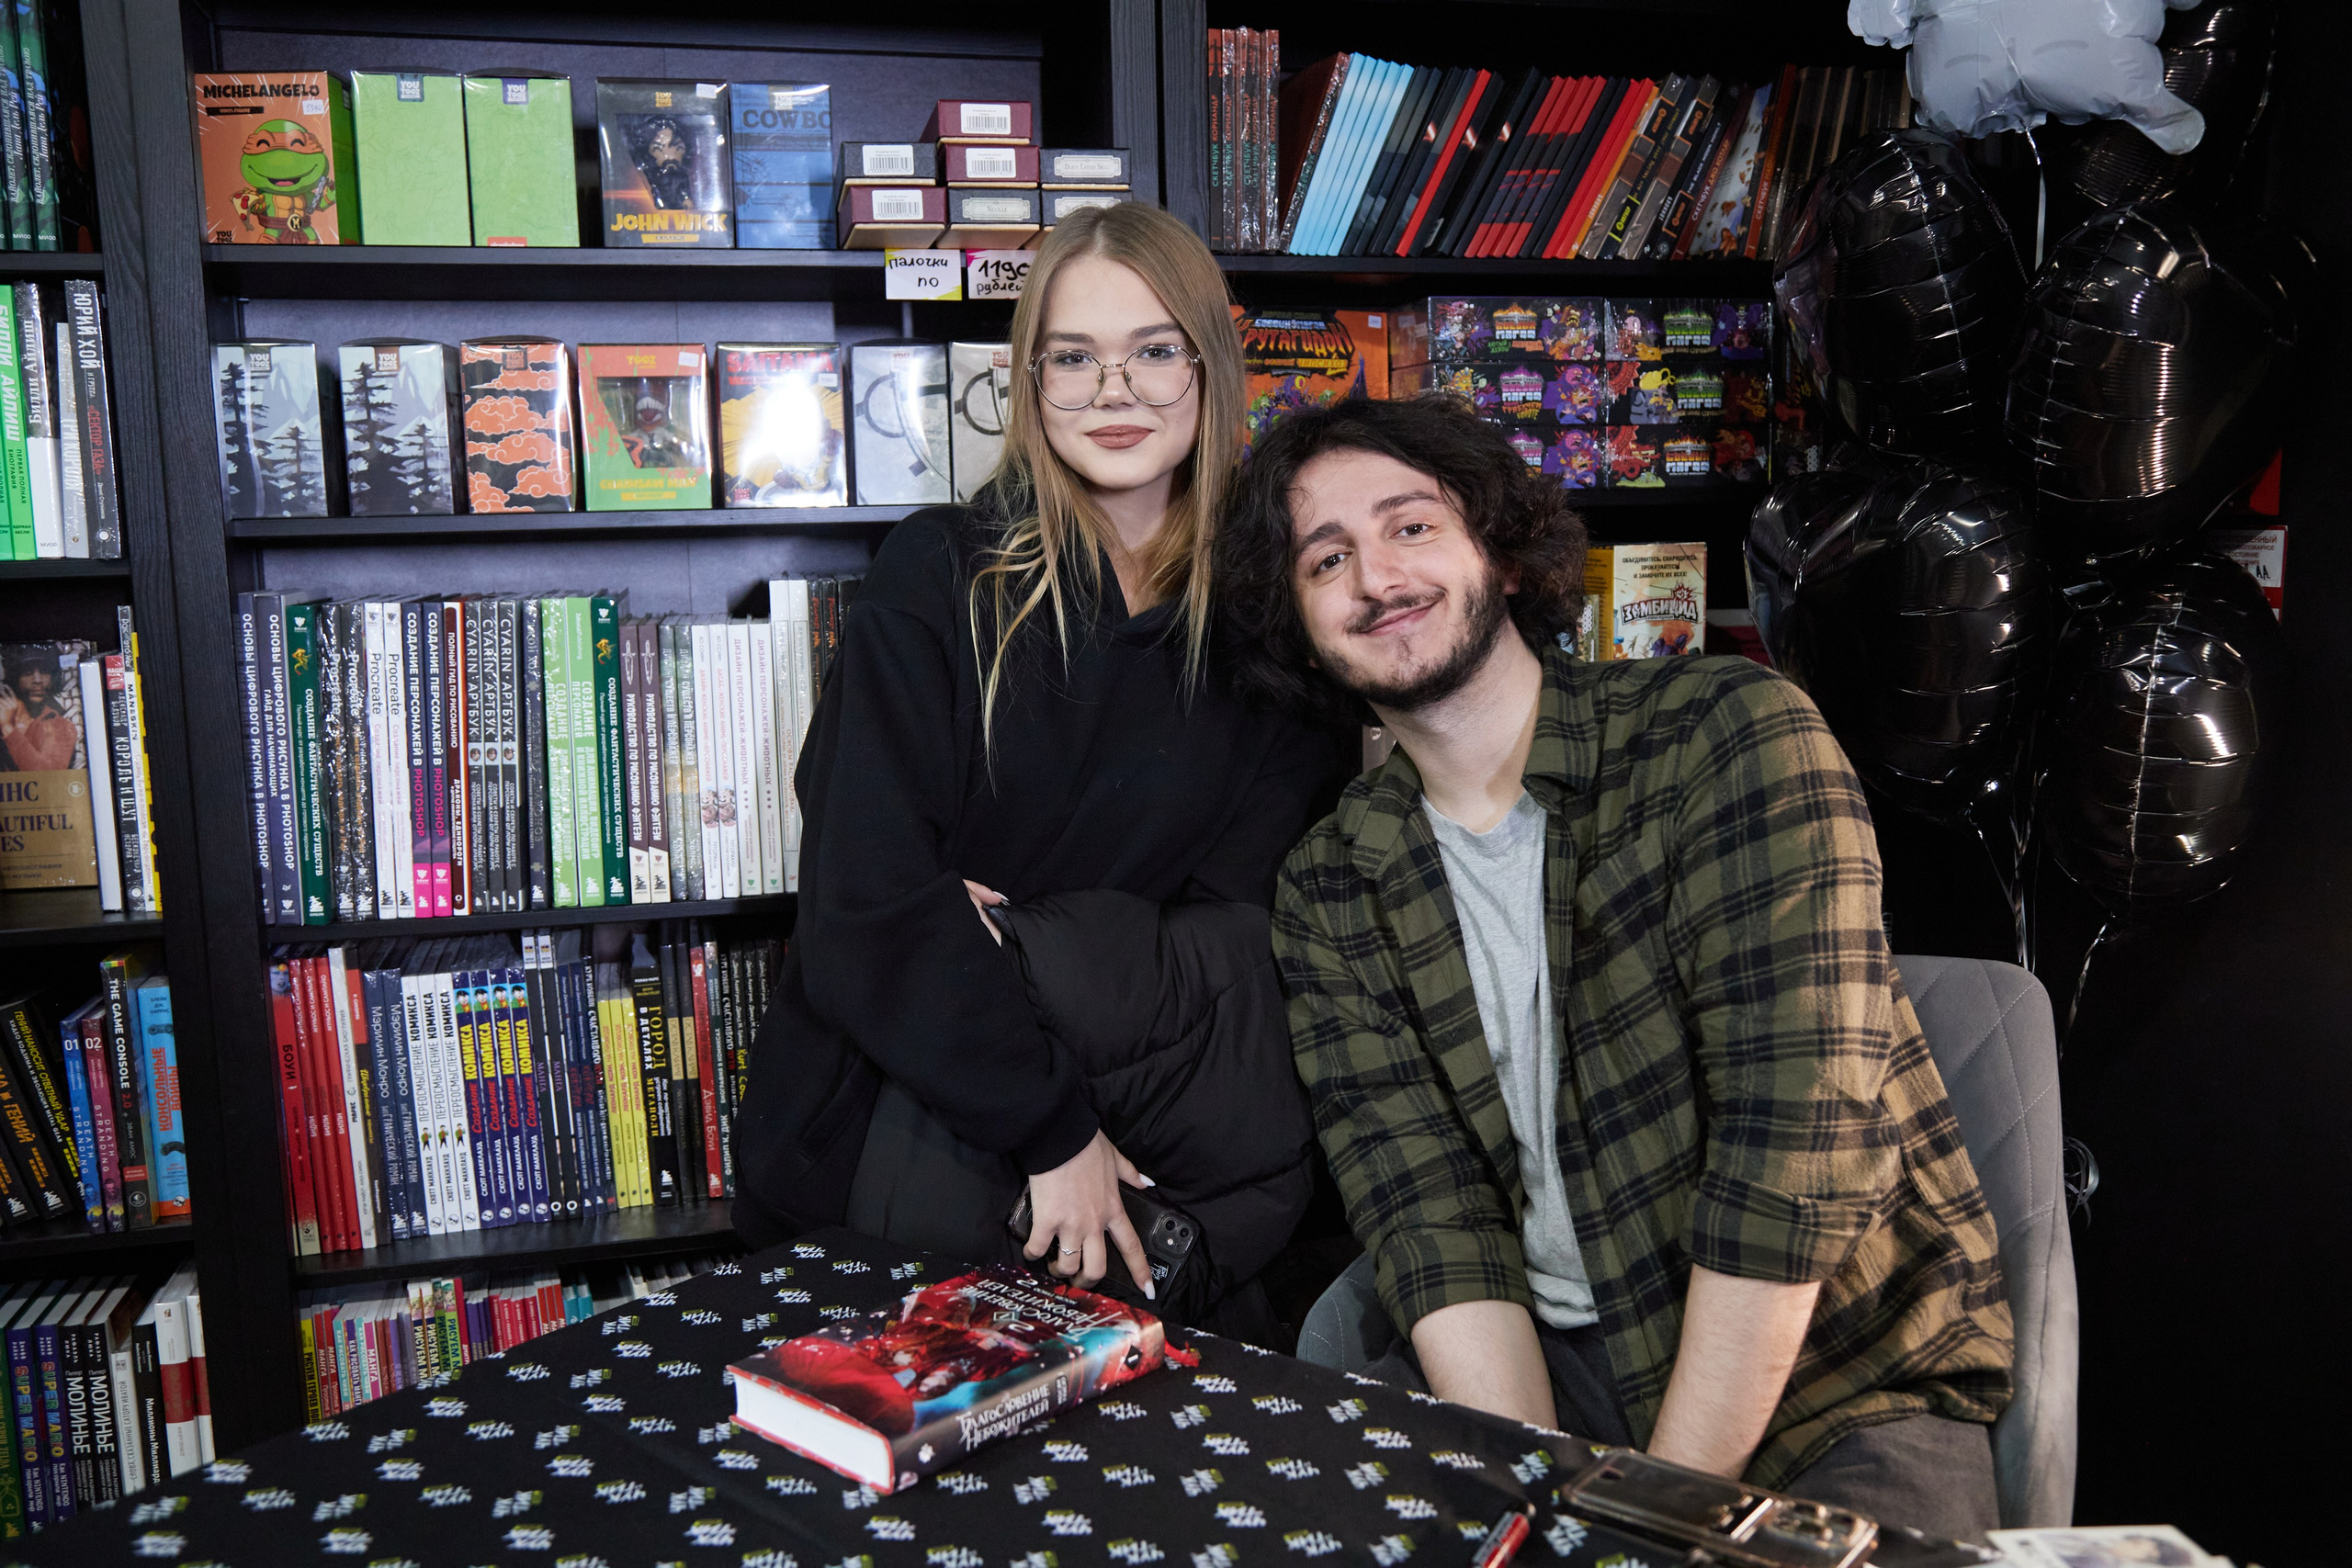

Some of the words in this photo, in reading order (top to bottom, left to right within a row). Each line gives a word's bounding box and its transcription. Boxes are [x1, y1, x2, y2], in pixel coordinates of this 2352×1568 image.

[24, 48, 33, 79] ТРАВОЮ
[400, 81, 420, 89] YOU
[36, 94, 44, 110] Рей
[204, 85, 320, 98] MICHELANGELO
[507, 85, 526, 93] YOU
[28, 101, 40, 166] СКЛОНИВШАЯСЯ
[1211, 94, 1219, 141] КОРИАНДР
[34, 166, 43, 205] ВАЙОЛЕТ,
[1756, 182, 1769, 220] СКЕТЧБУК
[611, 213, 669, 231] JOHN
[673, 213, 728, 231] WICK
[74, 293, 98, 335] ЮРИЙ
[23, 321, 37, 369] Айлиш
[77, 339, 101, 368] ХОЙ
[1240, 322, 1354, 357] РУТАГИДОН
[0, 375, 20, 442] АЙЛИШ
[28, 377, 42, 424] Билли
[243, 614, 254, 661] ОСНОВЫ
[269, 614, 281, 663] ОСНОВЫ
[406, 612, 419, 674] СОЗДАНИЕ
[428, 612, 441, 674] СОЗДАНИЕ
[447, 632, 457, 667] ПОЛНЫЙ
[467, 619, 477, 672] CYARIN
[483, 619, 494, 672] CYARIN
[502, 619, 513, 672] CYARIN
[733, 638, 742, 672] ДИЗАЙН
[757, 639, 766, 673] ДИЗАЙН
[370, 653, 382, 715] Procreate
[390, 654, 401, 715] Procreate
[448, 667, 458, 683] ГИД
[245, 665, 260, 735] ЦИФРОВОГО
[263, 689, 272, 711] ГАЙД
[266, 715, 274, 731] ДЛЯ
[272, 667, 287, 735] ЦИФРОВОГО
[410, 678, 423, 755] ПЕРСОНАЖЕЙ
[430, 677, 443, 755] ПЕРСОНАЖЕЙ
[448, 698, 459, 748] РИСОВАНИЮ
[467, 682, 478, 735] АРТБУК
[484, 682, 496, 735] АРТБУК
[502, 682, 514, 735] АРТБУК
[571, 682, 582, 739] ПЕРСОНАЖЕЙ
[608, 677, 618, 726] СОЗДАНИЕ
[626, 693, 639, 748] РУКОВОДСТВО
[645, 693, 658, 748] РУКОВОДСТВО
[392, 724, 401, 761] Создание
[759, 676, 772, 784] ПЕРСОНАЖЕЙ-ЖИВОТНЫХ
[115, 737, 131, 783] КОРОЛЬ
[251, 739, 265, 788] РИСУНКА
[266, 735, 277, 797] НАЧИНАЮЩИХ
[277, 739, 290, 790] РИСУНКА
[610, 728, 622, 812] ФАНТАСТИЧЕСКИХ
[649, 750, 658, 761] ПО
[309, 740, 321, 827] ФАНТАСТИЧЕСКИХ
[393, 761, 402, 805] персонажей
[434, 768, 445, 836] PHOTOSHOP
[628, 762, 640, 806] РИСОВАНИЮ
[649, 762, 661, 806] РИСОВАНИЮ
[121, 797, 136, 822] ШУТ
[631, 807, 643, 840] ФЭНТЕЗИ
[650, 807, 662, 840] ФЭНТЕЗИ
[255, 802, 269, 869] PHOTOSHOP
[282, 804, 294, 871] PHOTOSHOP
[312, 829, 323, 876] СУЩЕСТВ
[614, 815, 623, 858] СУЩЕСТВ
[109, 978, 120, 1000] THE
[111, 1003, 123, 1034] GAME
[648, 1006, 667, 1069] ГОРОД
[723, 996, 733, 1049] СЧАСТЛИВОГО
[15, 1040, 33, 1069] КОДЗИМА
[64, 1040, 79, 1051] 01
[85, 1037, 103, 1051] 02
[116, 1037, 130, 1089] CONSOLE
[283, 1043, 296, 1080] БОУИ
[371, 1006, 384, 1056] Мэрилин
[379, 1058, 390, 1098] Монро
[390, 1004, 402, 1055] Мэрилин
[397, 1056, 409, 1095] Монро
[460, 1023, 478, 1080] КОМИКСА
[479, 1021, 496, 1078] КОМИКСА
[497, 1020, 515, 1075] КОМИКСА
[514, 1018, 533, 1075] КОМИКСА
[639, 1018, 652, 1070] ДЕТАЛЯХ
[737, 1049, 748, 1069] Kurt
[14, 1010, 29, 1034] ГЕНИЙ
[22, 1034, 44, 1071] НАНОСИТ
[39, 1071, 62, 1110] ОТВЕТНЫЙ
[55, 1111, 70, 1132] УДАР
[152, 1047, 169, 1132] КОНСОЛЬНЫЕ
[428, 1042, 447, 1120] ПЕРЕОСМЫСЛЕНИЕ
[445, 1040, 463, 1118] ПЕРЕОСМЫСЛЕНИЕ
[537, 1062, 547, 1092] МАНГА
[553, 1060, 562, 1091] МАНГА
[4, 1102, 37, 1143] ГЕНИЙ
[121, 1093, 131, 1108] 2.0
[720, 1114, 729, 1134] ДИК
[74, 1106, 88, 1174] STRANDING
[83, 1121, 94, 1159] DEATH
[96, 1104, 110, 1172] STRANDING
[105, 1119, 114, 1156] DEATH
[722, 1145, 732, 1176] ФИЛИП
[442, 1154, 452, 1185] МАККЛАУД
[459, 1152, 469, 1182] МАККЛАУД
[446, 1185, 454, 1202] СКОТТ
[957, 1286, 1086, 1342] БЛАГОСЛОВЕНИЕ
[976, 1279, 1122, 1330] НЕБОЖИТЕЛЕЙ
[368, 1348, 379, 1383] МАНГА
[413, 1325, 428, 1367] РИСУЕМ
[426, 1323, 441, 1365] РИСУЕМ
[15, 1365, 33, 1414] SUPER
[42, 1361, 59, 1409] SUPER
[350, 1353, 361, 1385] РИСОВАТЬ
[66, 1377, 91, 1455] МОЛИНЬЕ
[90, 1376, 115, 1453] МОЛИНЬЕ
[308, 1382, 320, 1407] ГЕРОЕВ
[956, 1383, 1051, 1443] БЛАГОСЛОВЕНИЕ
[20, 1416, 38, 1462] MARIO
[46, 1412, 64, 1457] MARIO
[124, 1426, 134, 1459] СКАЗАННЫЕ
[145, 1398, 156, 1441] Миллионы
[965, 1398, 1049, 1452] НЕБОЖИТЕЛЕЙ
[52, 1463, 61, 1494] покорила
[61, 1475, 70, 1506] NINTENDO
